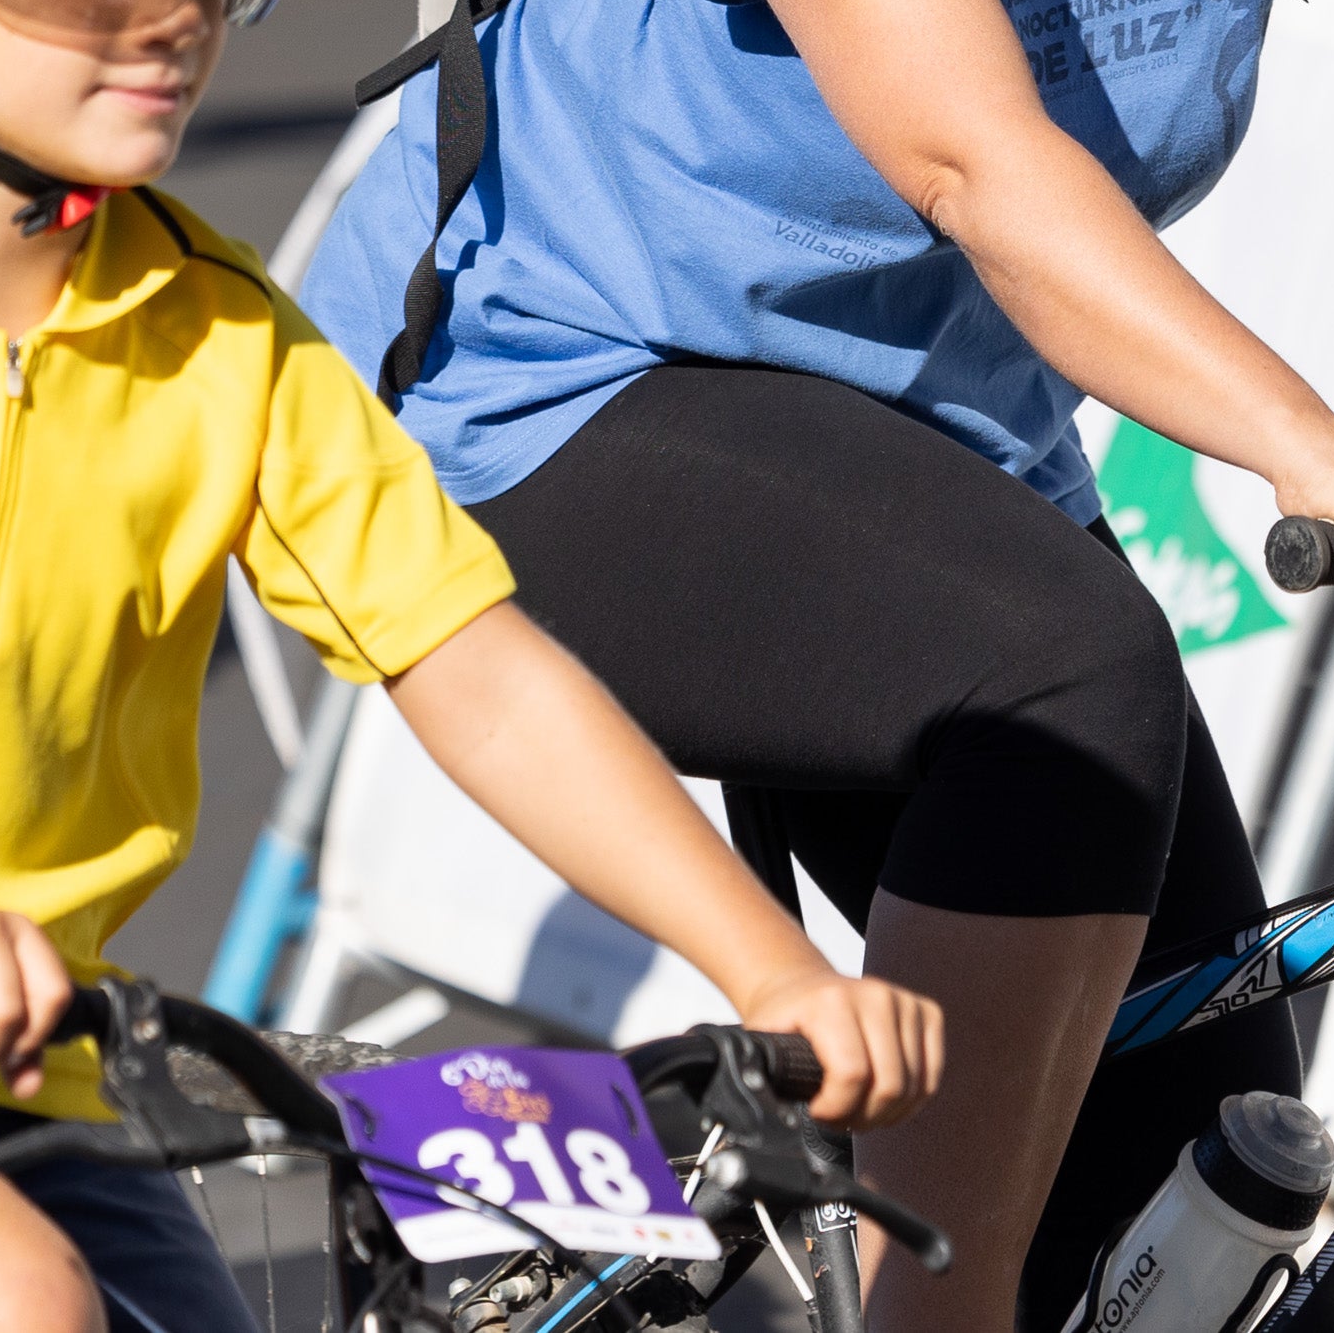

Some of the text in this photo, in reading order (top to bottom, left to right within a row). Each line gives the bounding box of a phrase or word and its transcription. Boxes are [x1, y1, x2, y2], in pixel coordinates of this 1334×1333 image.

[775, 219, 878, 270] Valladoli
[881, 244, 899, 258] de
[417, 1122, 652, 1217] 318
